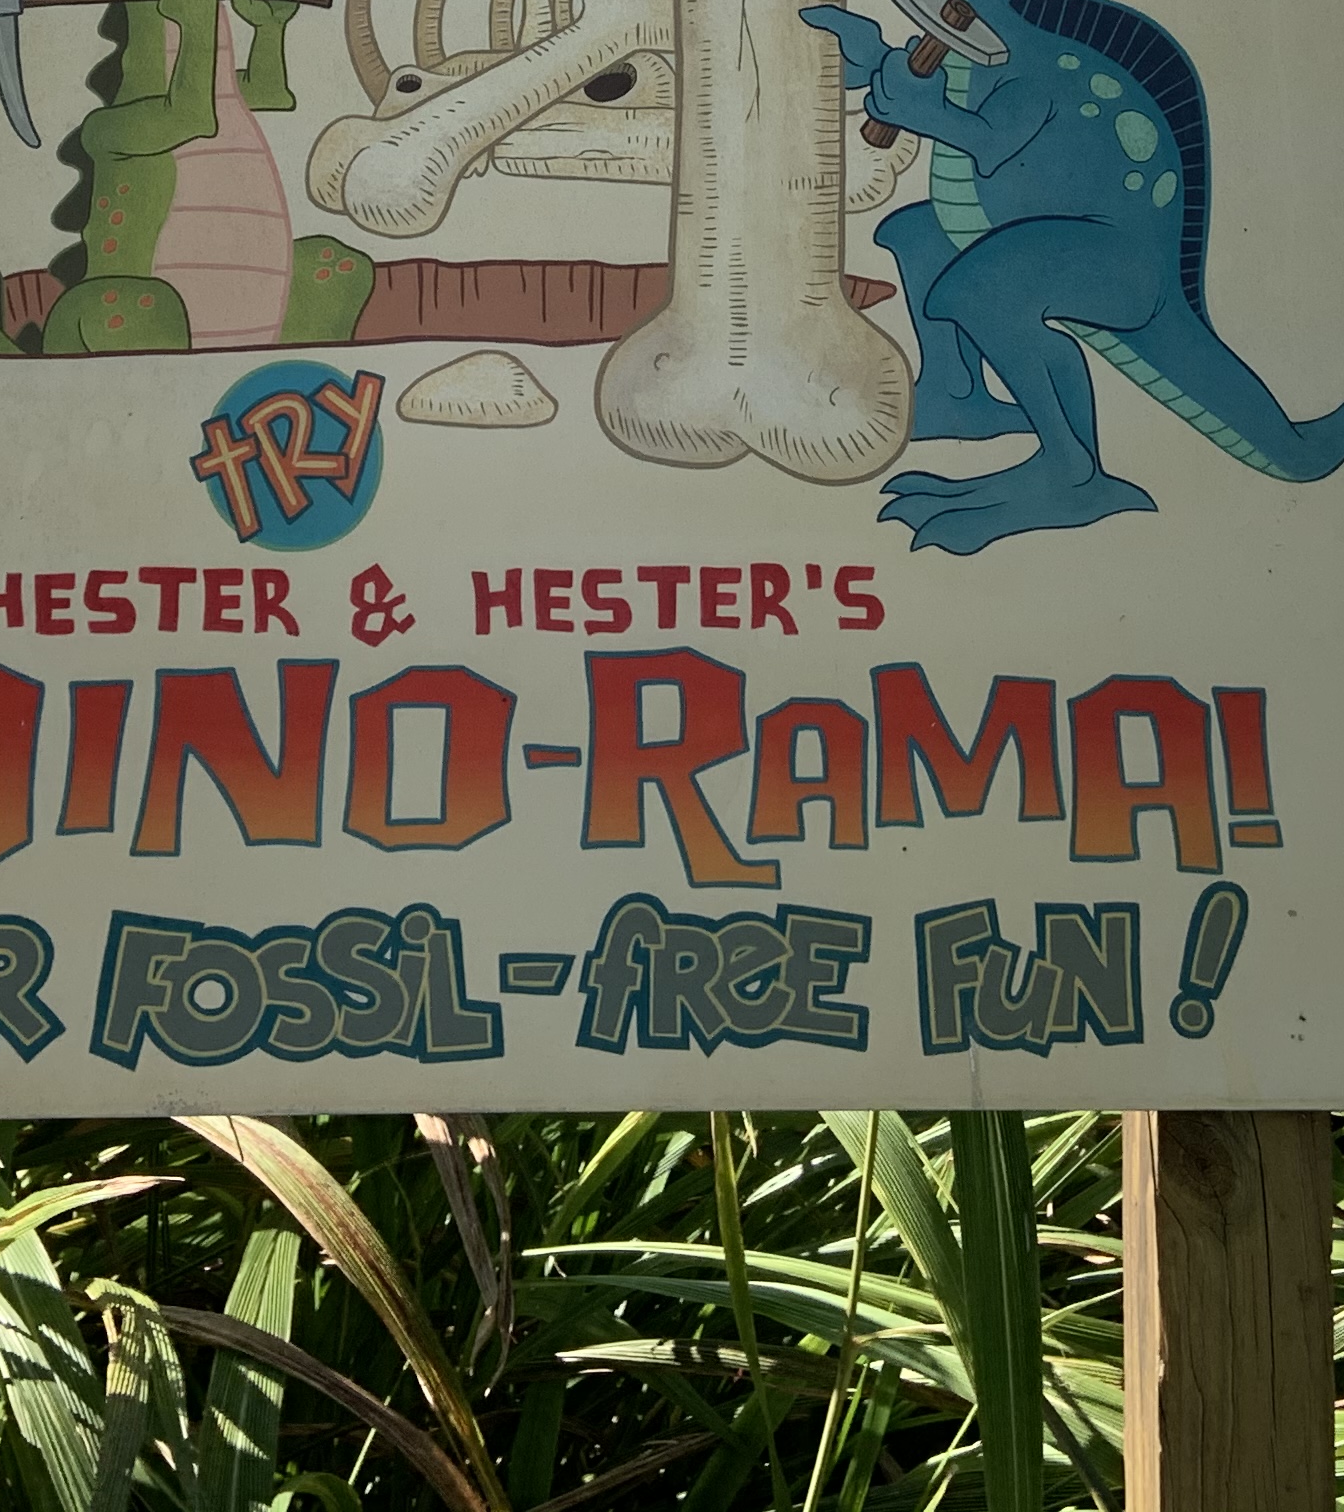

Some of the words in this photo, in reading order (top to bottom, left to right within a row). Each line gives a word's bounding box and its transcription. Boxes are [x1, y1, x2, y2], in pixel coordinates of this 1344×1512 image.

[189, 369, 386, 543] tRY
[349, 563, 416, 648] &
[471, 562, 886, 636] HESTER'S
